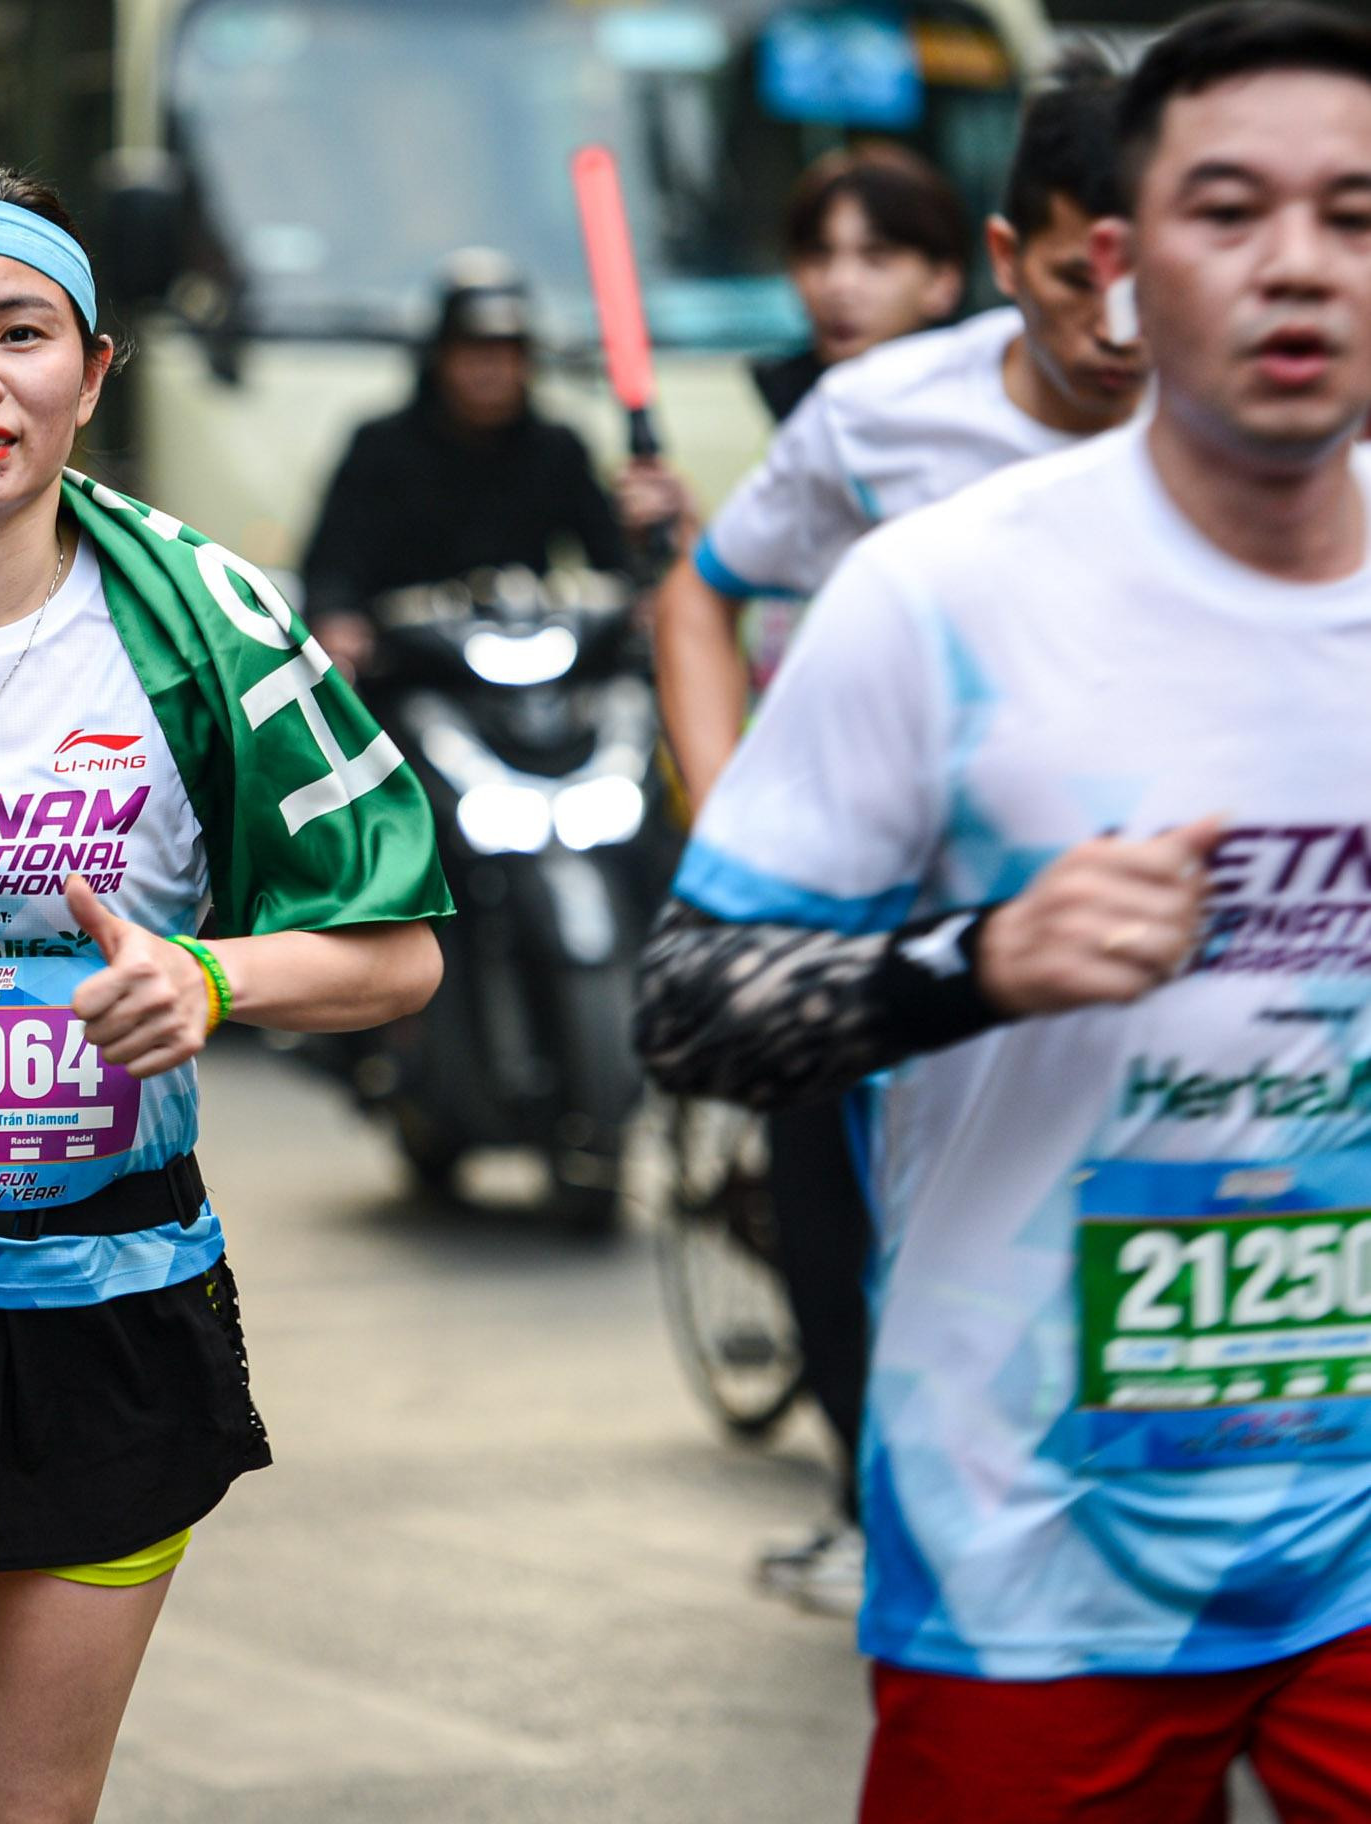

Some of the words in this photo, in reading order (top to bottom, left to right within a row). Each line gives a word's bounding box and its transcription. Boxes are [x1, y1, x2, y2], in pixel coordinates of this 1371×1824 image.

[54, 755, 147, 773] LI-NING
[26, 1112, 79, 1125] Diamond
[10, 1137, 42, 1145] Racekit
[66, 1135, 93, 1143] Medal
[12, 1185, 66, 1201] YEAR!
